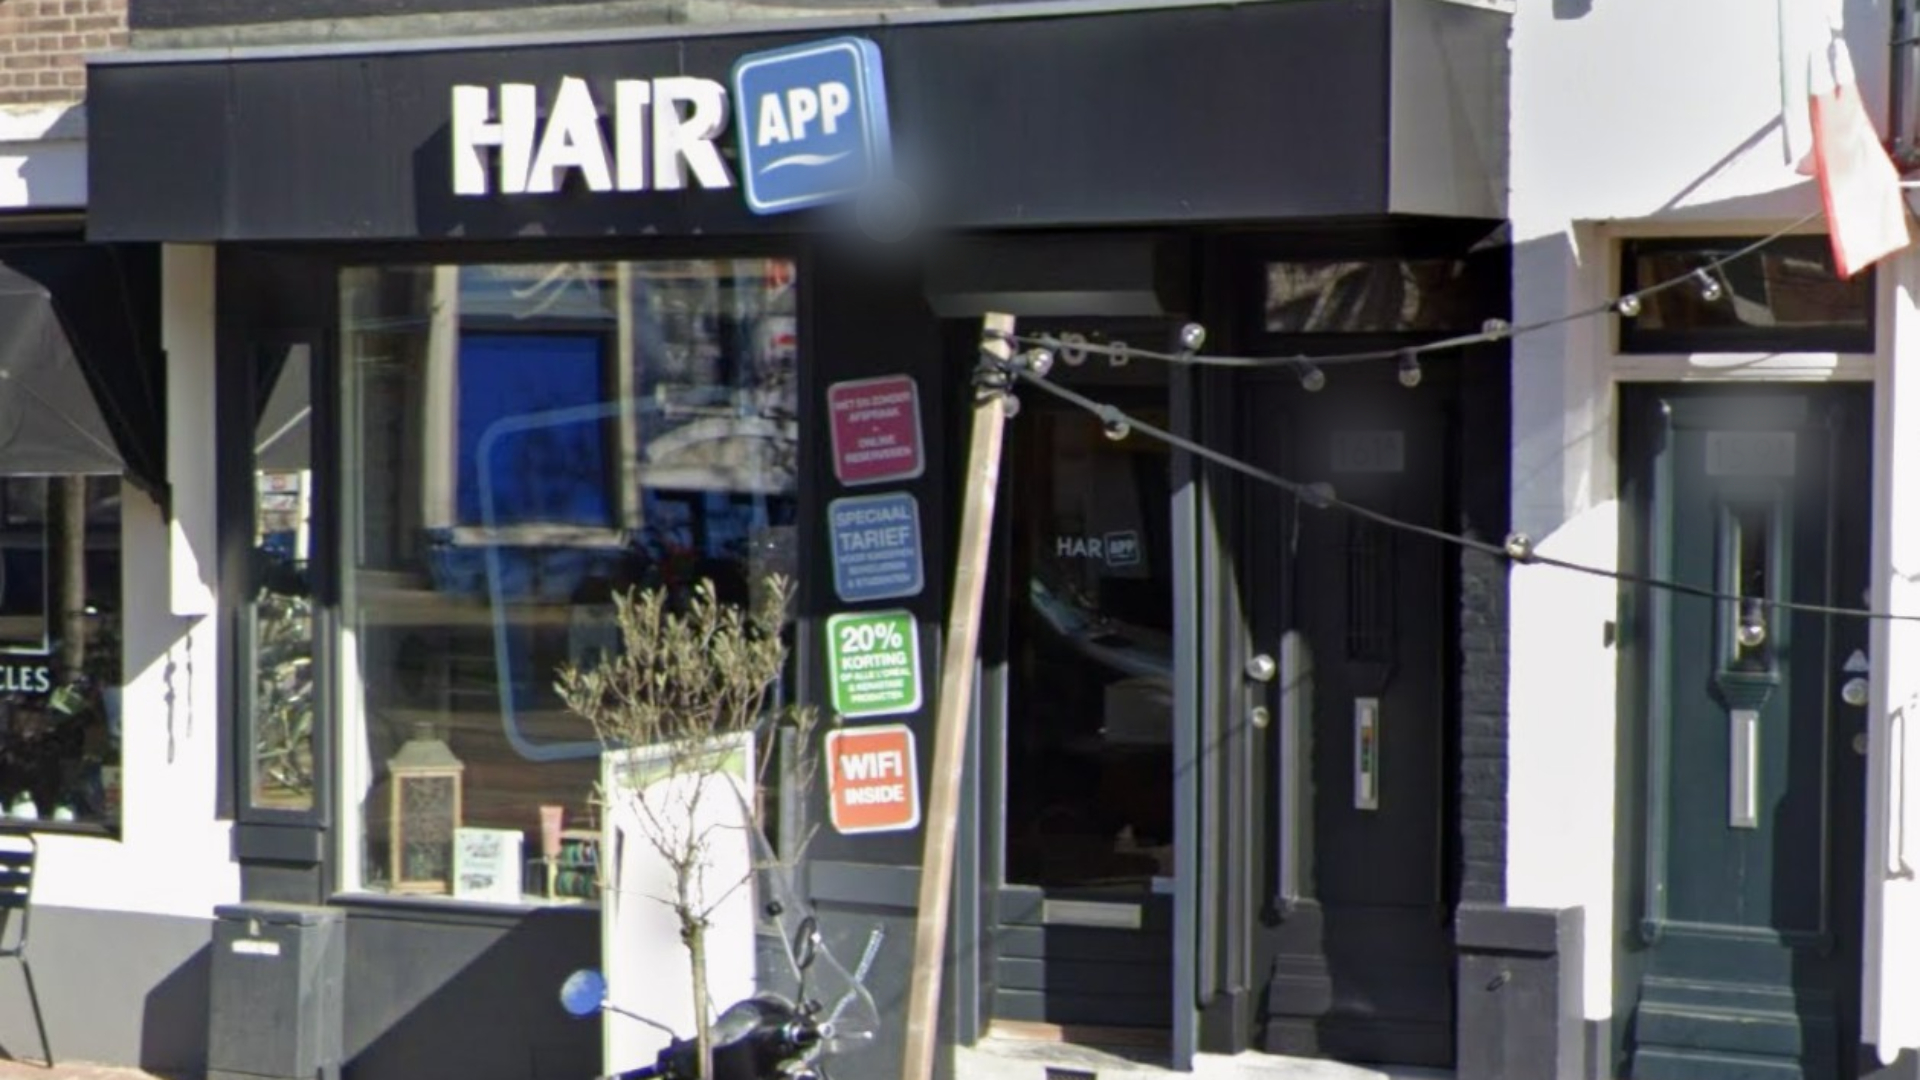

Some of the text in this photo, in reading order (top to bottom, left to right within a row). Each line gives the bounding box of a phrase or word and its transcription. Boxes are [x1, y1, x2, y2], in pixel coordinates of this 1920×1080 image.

[452, 76, 851, 195] HAIR APP
[837, 506, 910, 526] SPECIAAL
[840, 527, 909, 551] TARIEF
[841, 622, 902, 652] 20%
[843, 651, 906, 670] KORTING
[841, 752, 902, 780] WIFI
[844, 784, 905, 805] INSIDE
